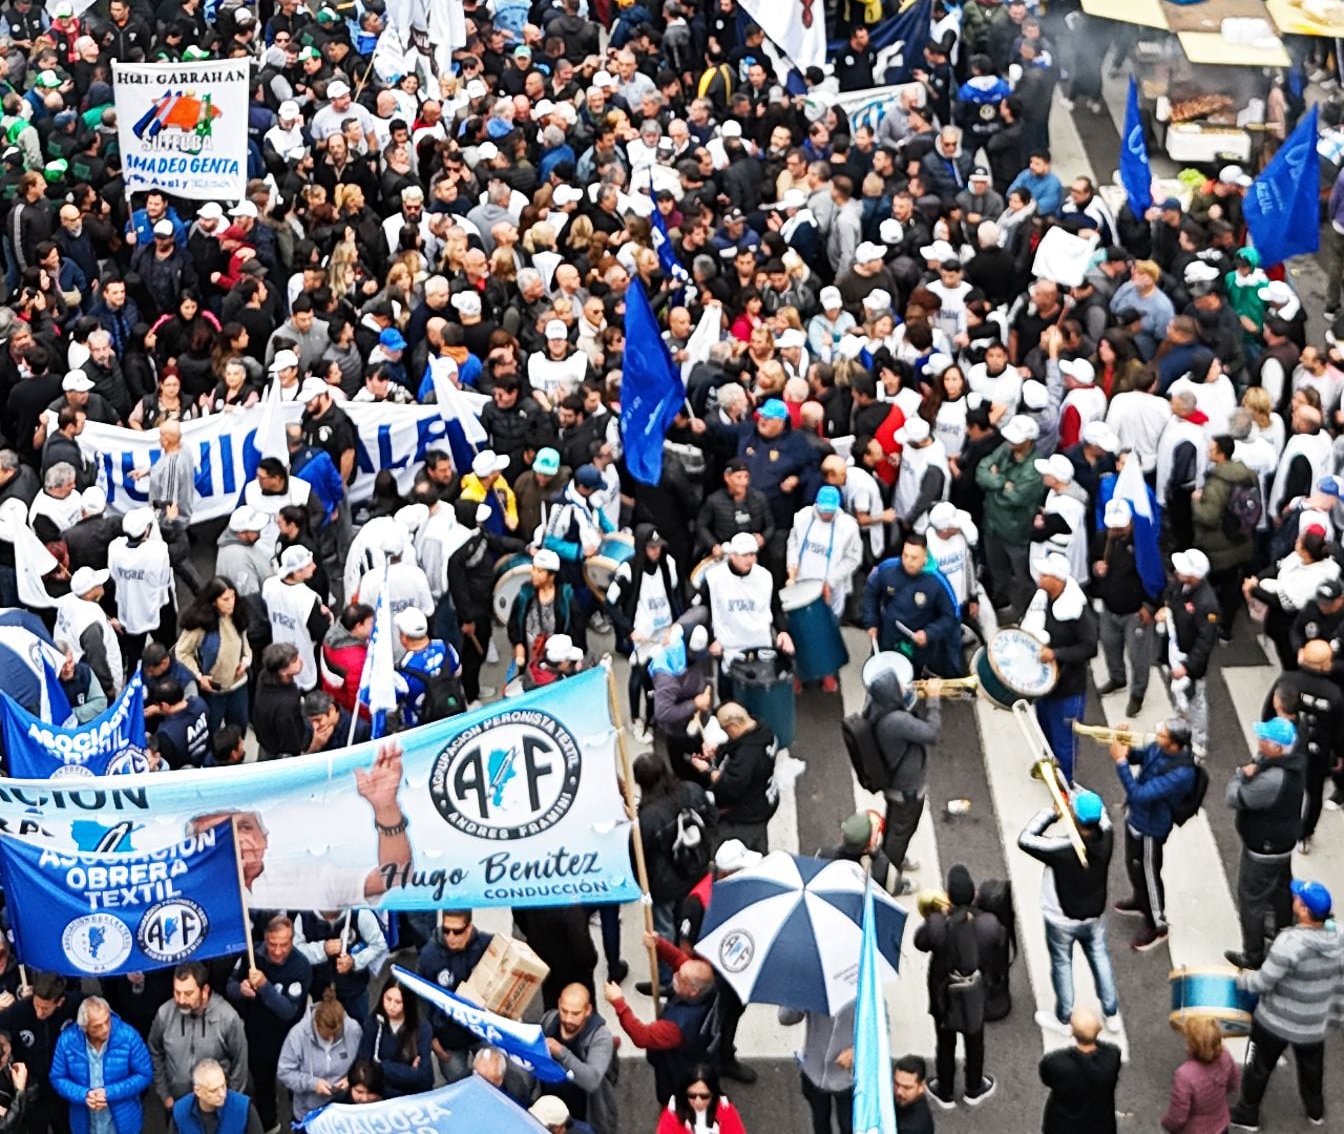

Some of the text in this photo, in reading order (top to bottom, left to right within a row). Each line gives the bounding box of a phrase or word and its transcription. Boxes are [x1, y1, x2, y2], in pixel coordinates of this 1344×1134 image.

[156, 69, 246, 85] GARRAHAN
[126, 153, 240, 177] AMADEO GENTA
[483, 709, 557, 733] PERONISTA
[553, 726, 580, 769] TEXTIL
[446, 792, 573, 841] ANDRES FRAMINI
[66, 858, 189, 891] OBRERA
[377, 861, 467, 902] Hugo
[483, 879, 610, 900] CONDUCCIÓN
[83, 880, 184, 910] TEXTIL
